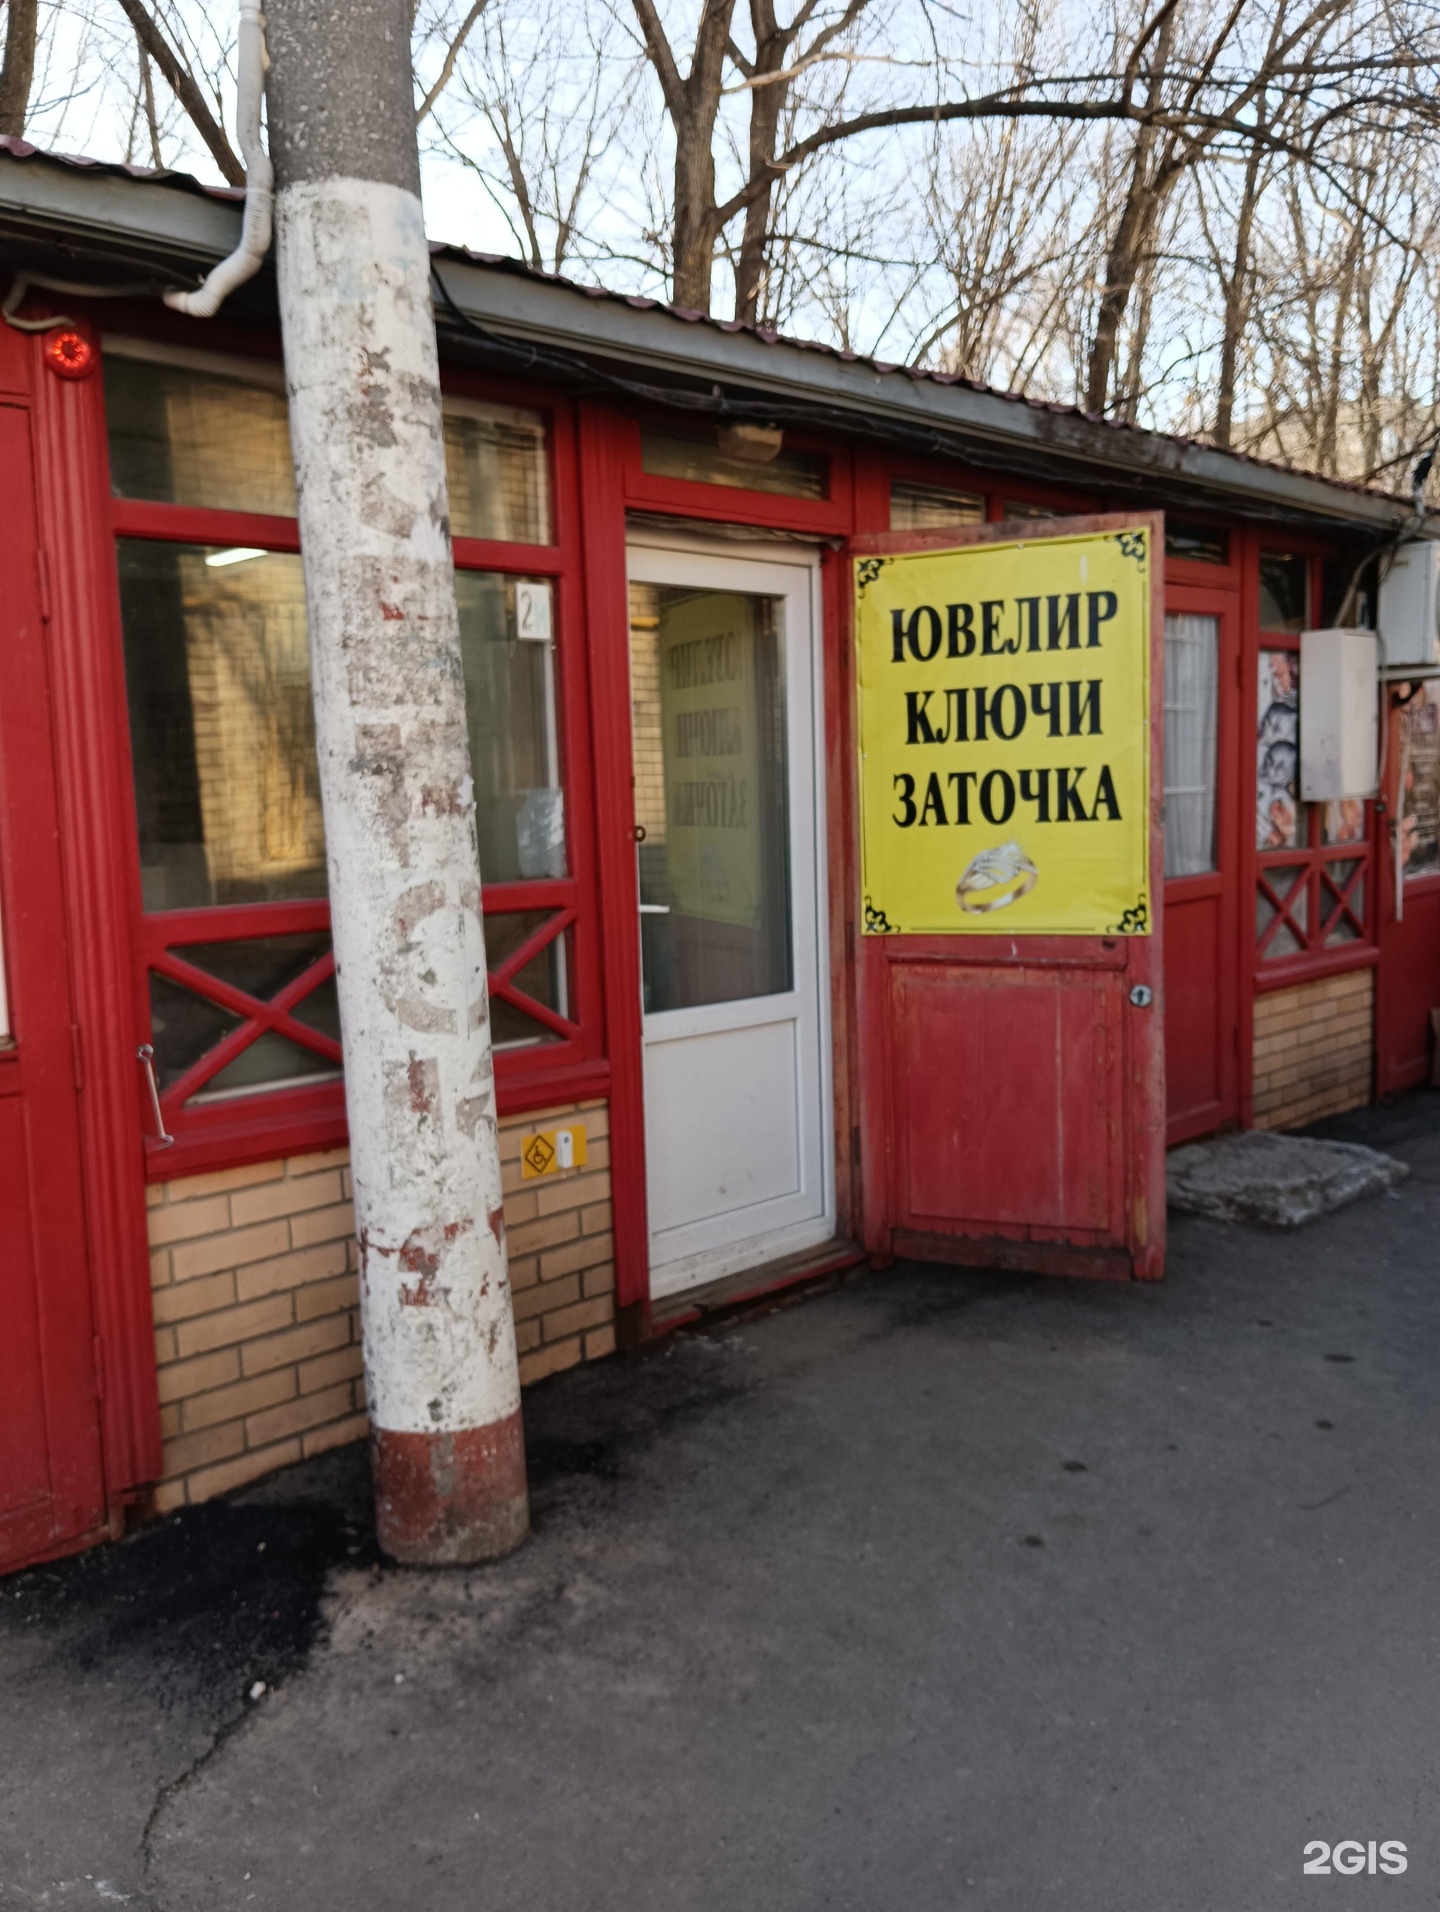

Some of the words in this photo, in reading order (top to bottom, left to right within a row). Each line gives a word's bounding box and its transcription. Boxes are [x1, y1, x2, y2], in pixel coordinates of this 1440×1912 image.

[890, 590, 1118, 663] ЮВЕЛИР
[904, 679, 1104, 745] КЛЮЧИ
[892, 765, 1122, 828] ЗАТОЧКА
